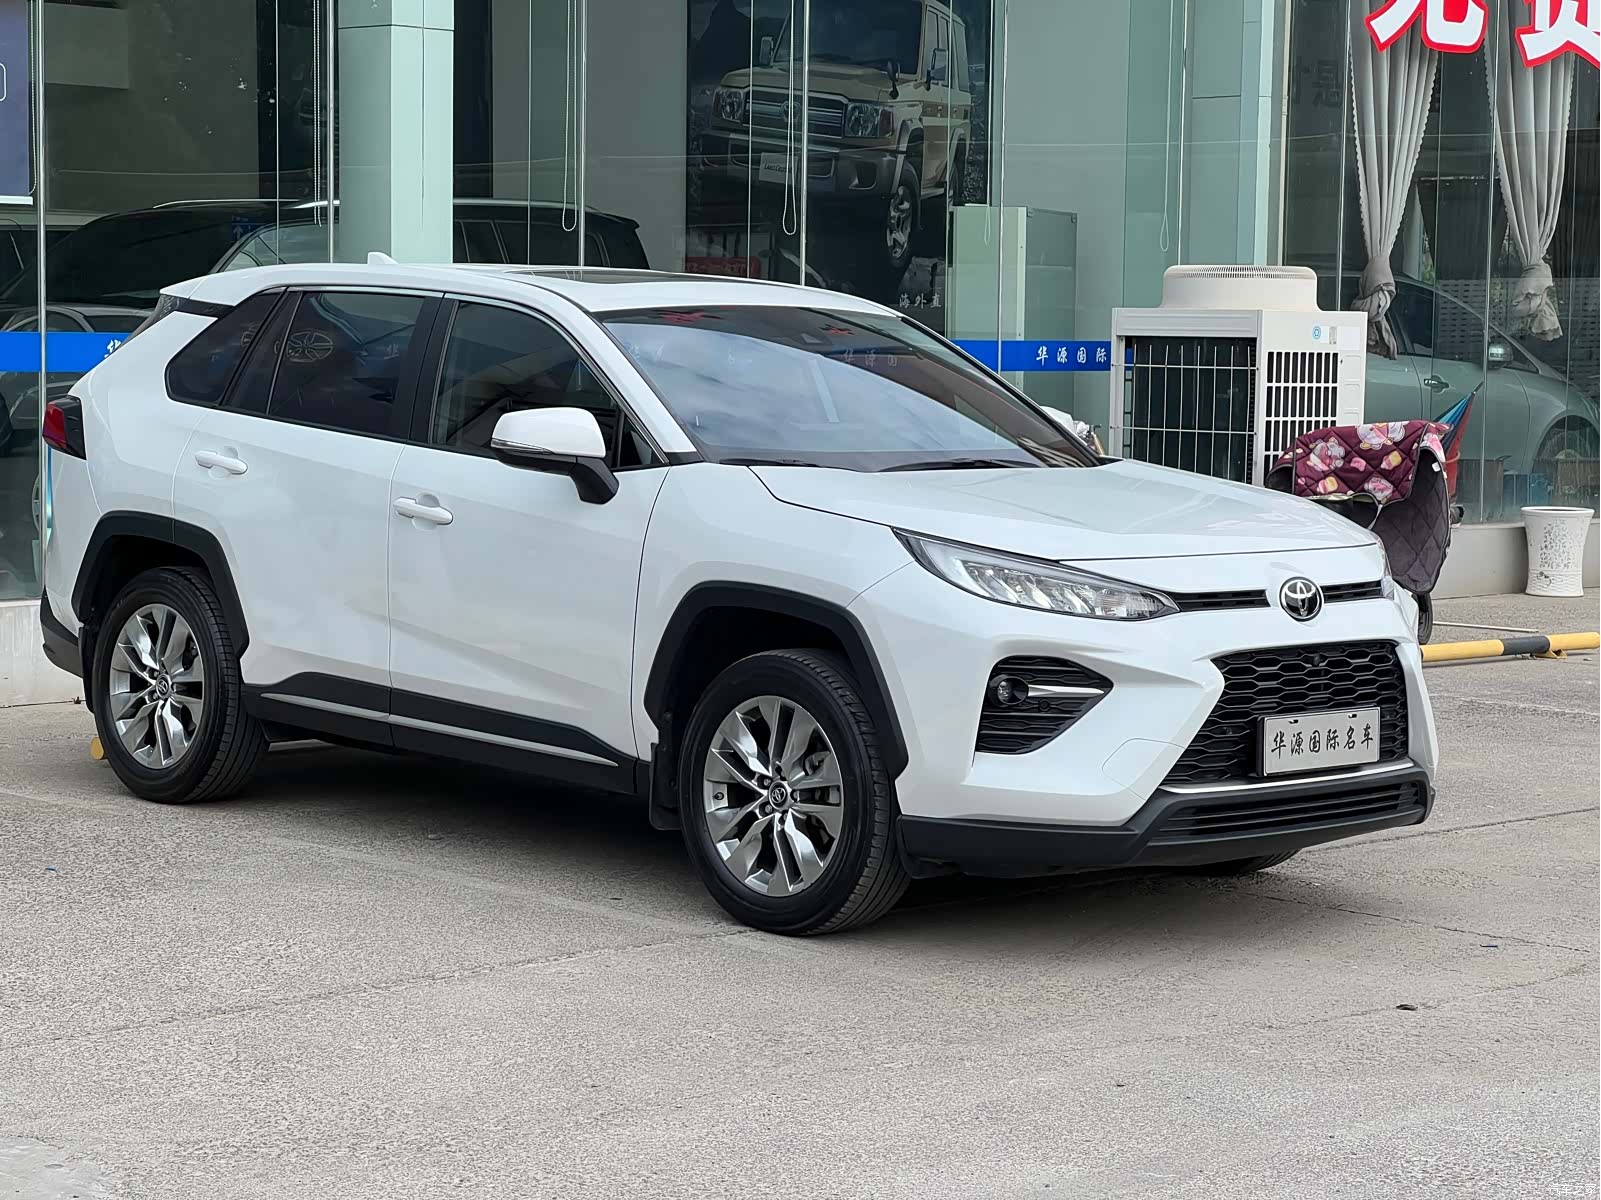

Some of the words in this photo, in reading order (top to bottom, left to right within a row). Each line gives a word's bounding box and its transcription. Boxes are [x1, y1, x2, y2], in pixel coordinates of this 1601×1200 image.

[1036, 345, 1107, 366] 华源国际
[1270, 722, 1373, 759] 华源国际名车
